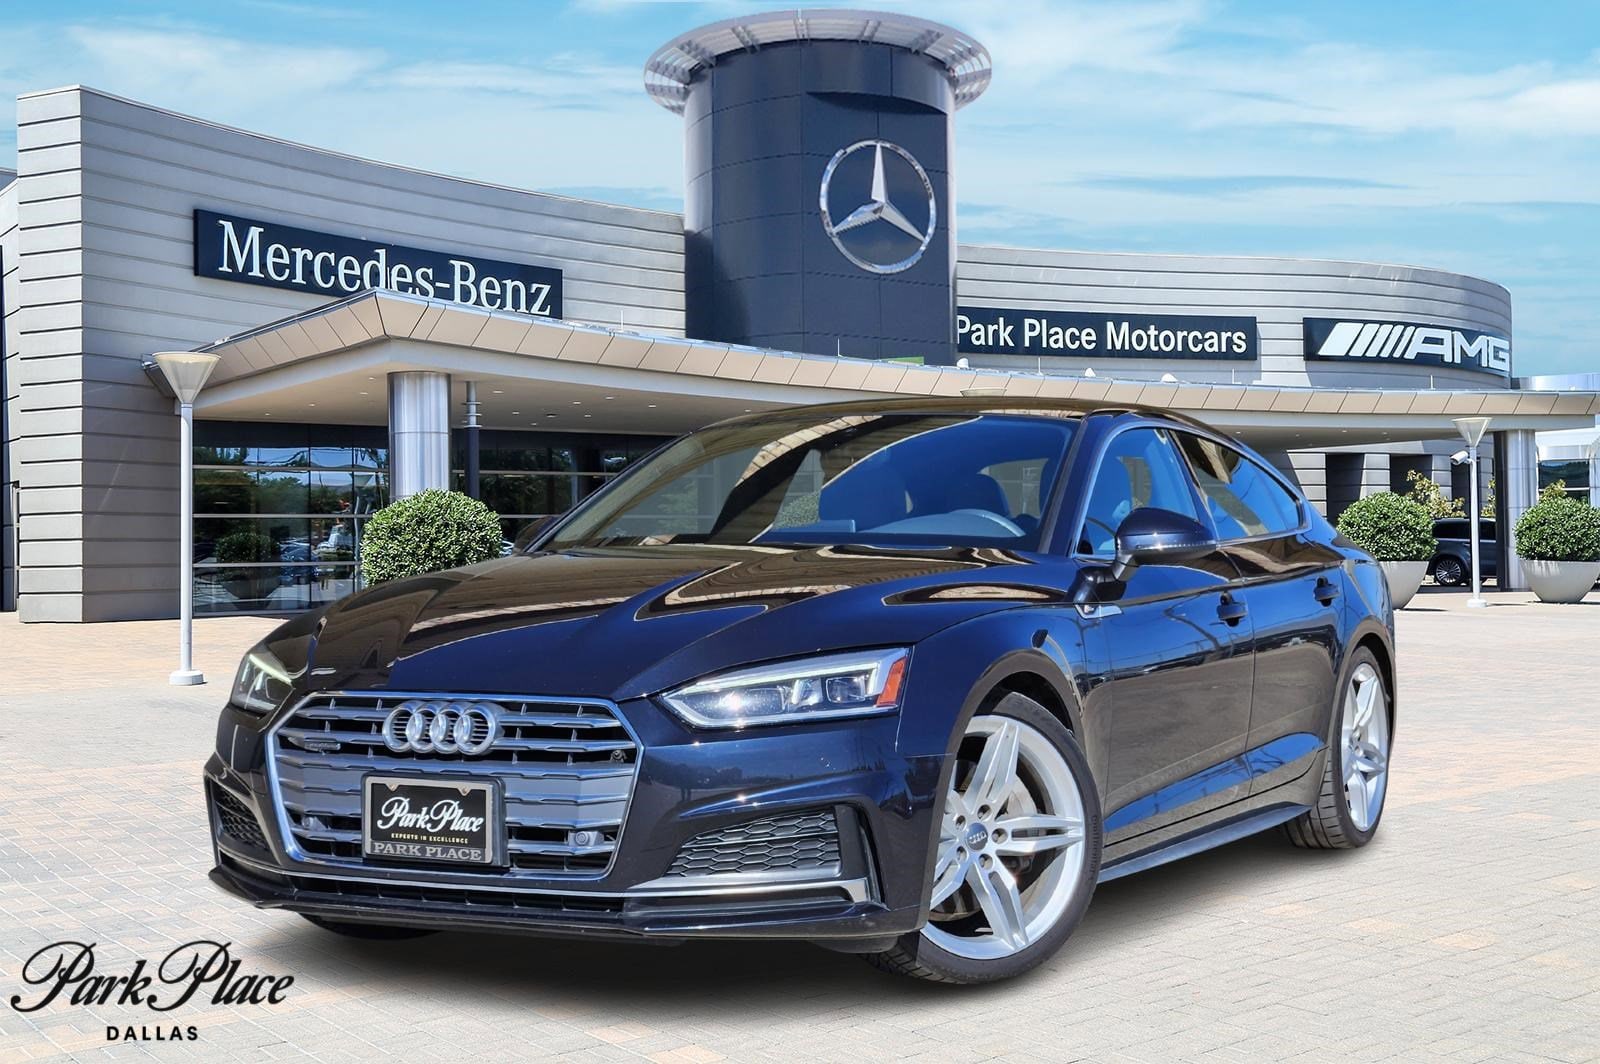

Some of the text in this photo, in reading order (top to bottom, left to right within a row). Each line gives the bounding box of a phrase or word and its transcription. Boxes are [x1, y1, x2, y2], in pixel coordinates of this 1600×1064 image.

[217, 219, 552, 317] Mercedes-Benz
[957, 315, 1247, 353] Park Place Motorcars
[1403, 327, 1510, 372] AMG
[377, 796, 484, 833] Park Place
[374, 842, 482, 861] PARK PLACE
[391, 832, 419, 840] EXPERTS
[429, 835, 469, 844] EXCELLENCE
